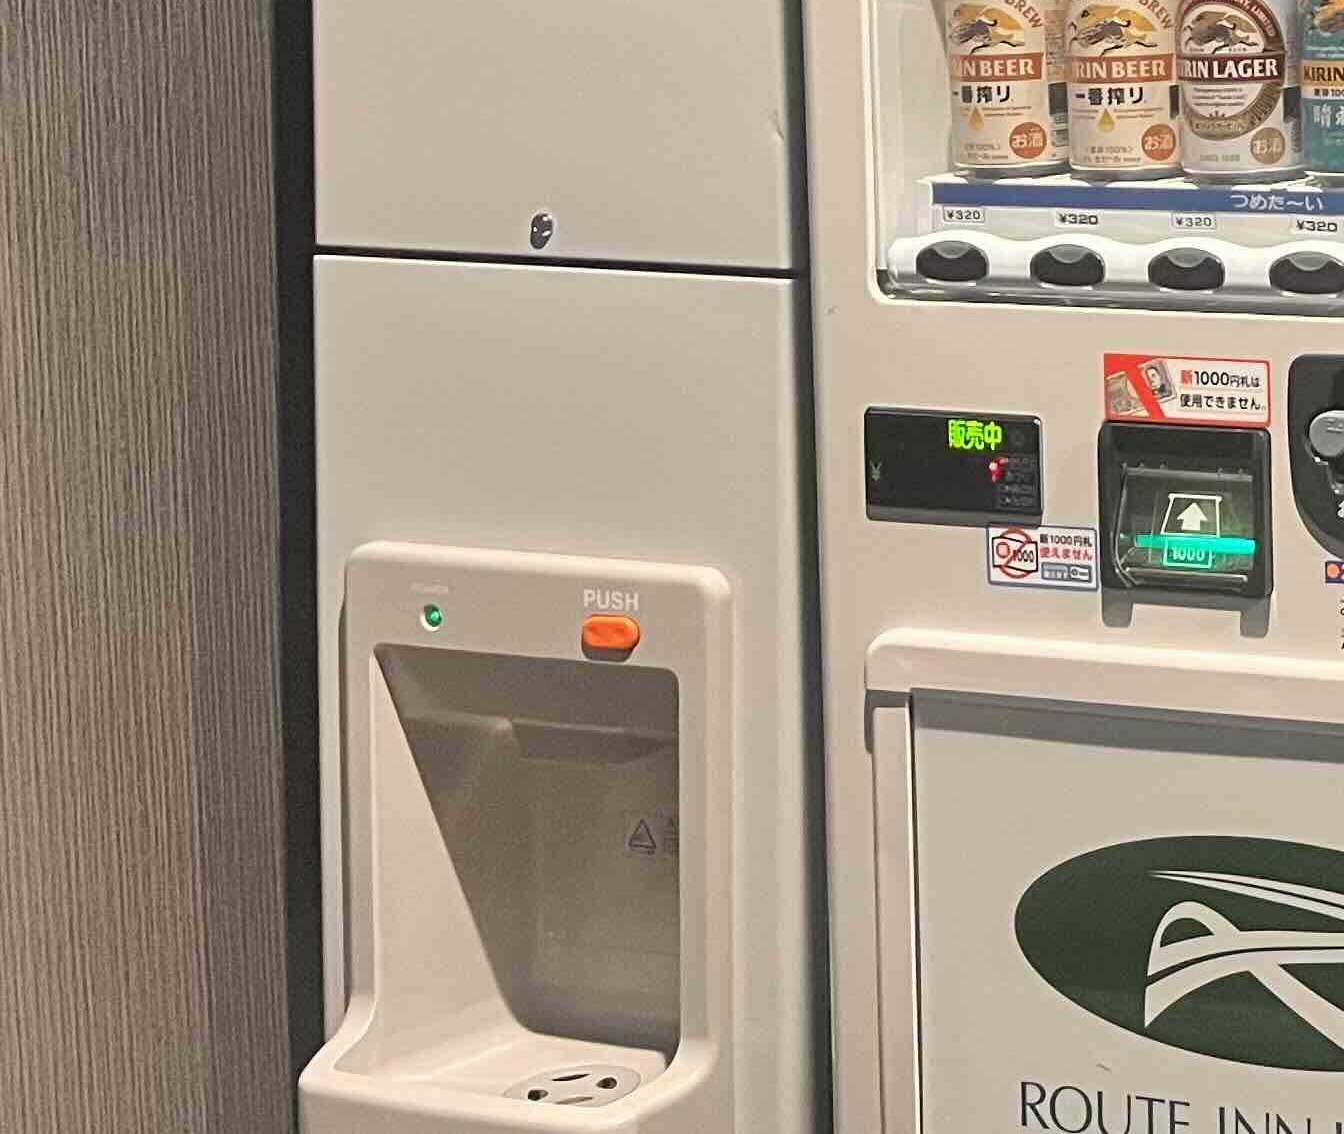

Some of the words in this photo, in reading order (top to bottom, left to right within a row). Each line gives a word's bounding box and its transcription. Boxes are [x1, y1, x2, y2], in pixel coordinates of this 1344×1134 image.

[980, 59, 1035, 77] BEER
[1075, 61, 1107, 79] RIN
[1111, 59, 1166, 78] BEER
[1182, 59, 1209, 79] RIN
[1212, 58, 1279, 79] LAGER
[1011, 129, 1044, 148] お酒
[1143, 134, 1173, 151] お酒
[946, 209, 981, 221] ¥320
[1059, 212, 1099, 226] ¥320
[1175, 217, 1212, 228] ¥320
[1296, 220, 1338, 233] ¥320
[1181, 369, 1261, 388] 新1000円札は
[948, 419, 1002, 451] 販売中
[583, 588, 640, 611] PUSH
[1020, 1080, 1191, 1134] ROUTE
